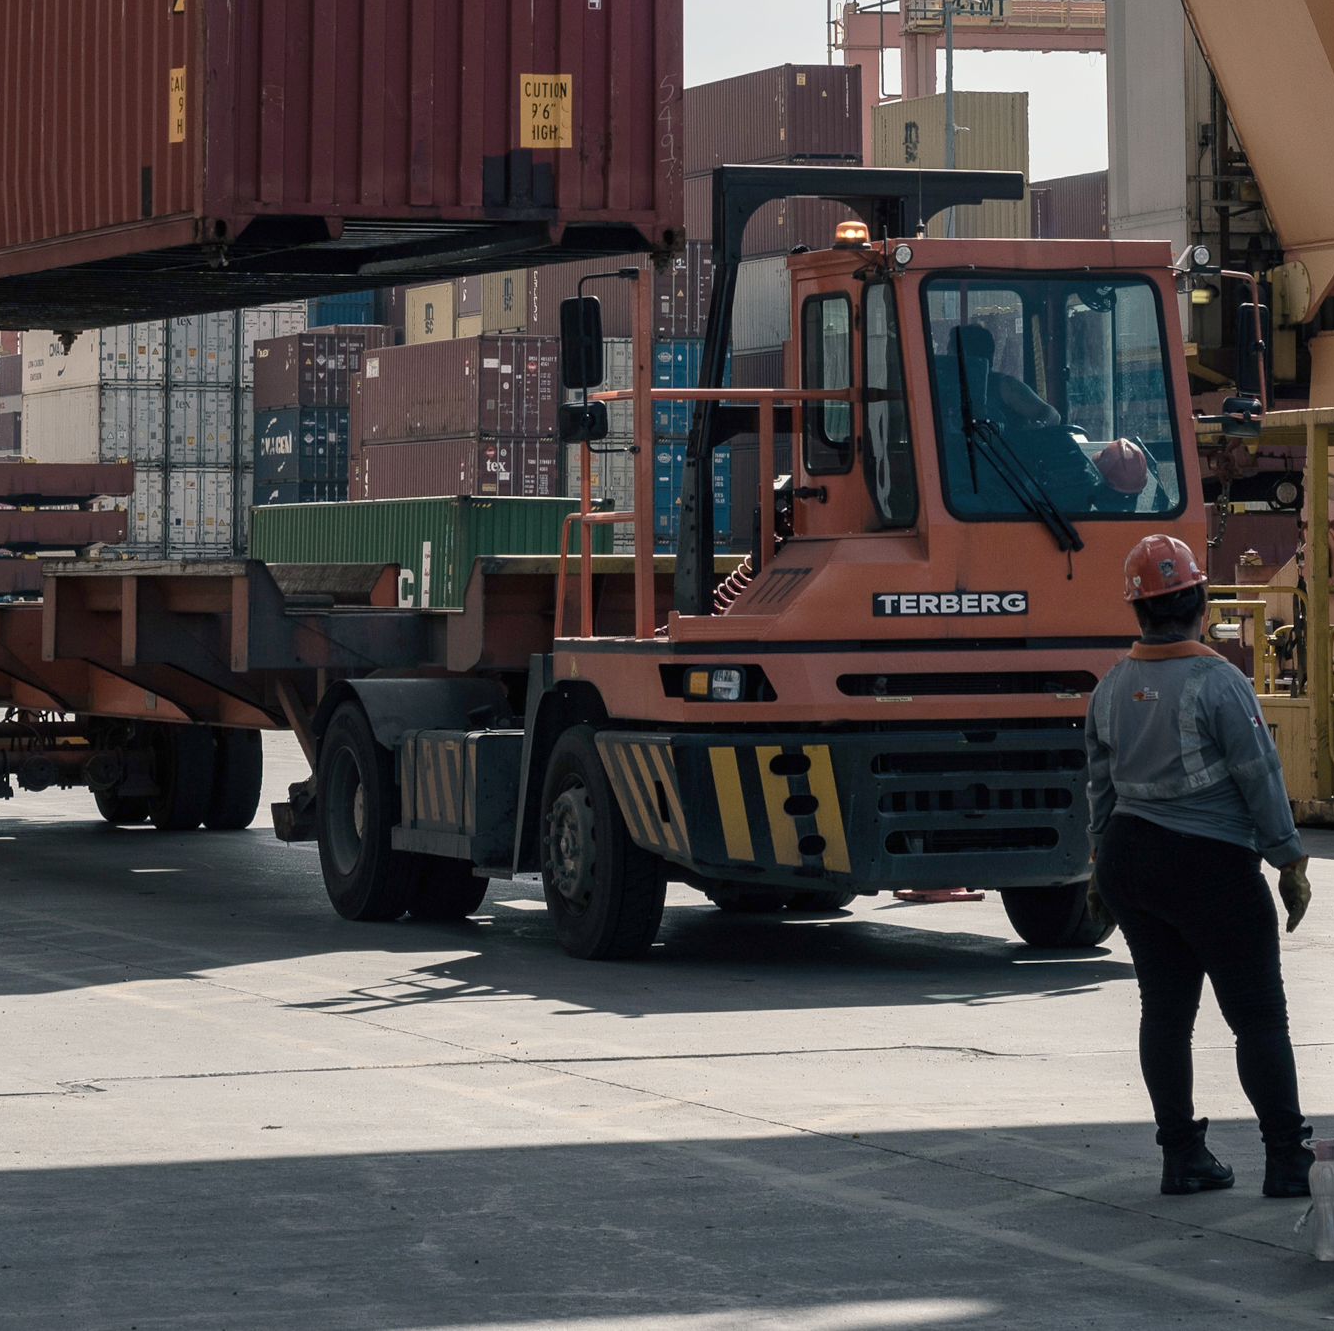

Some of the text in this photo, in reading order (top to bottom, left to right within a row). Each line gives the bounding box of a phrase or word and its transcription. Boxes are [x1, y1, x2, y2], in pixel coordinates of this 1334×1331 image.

[525, 82, 567, 98] CUTION
[532, 124, 558, 140] HIGH
[176, 399, 191, 409] tex
[486, 459, 506, 472] tex
[877, 594, 1026, 614] TERBERG
